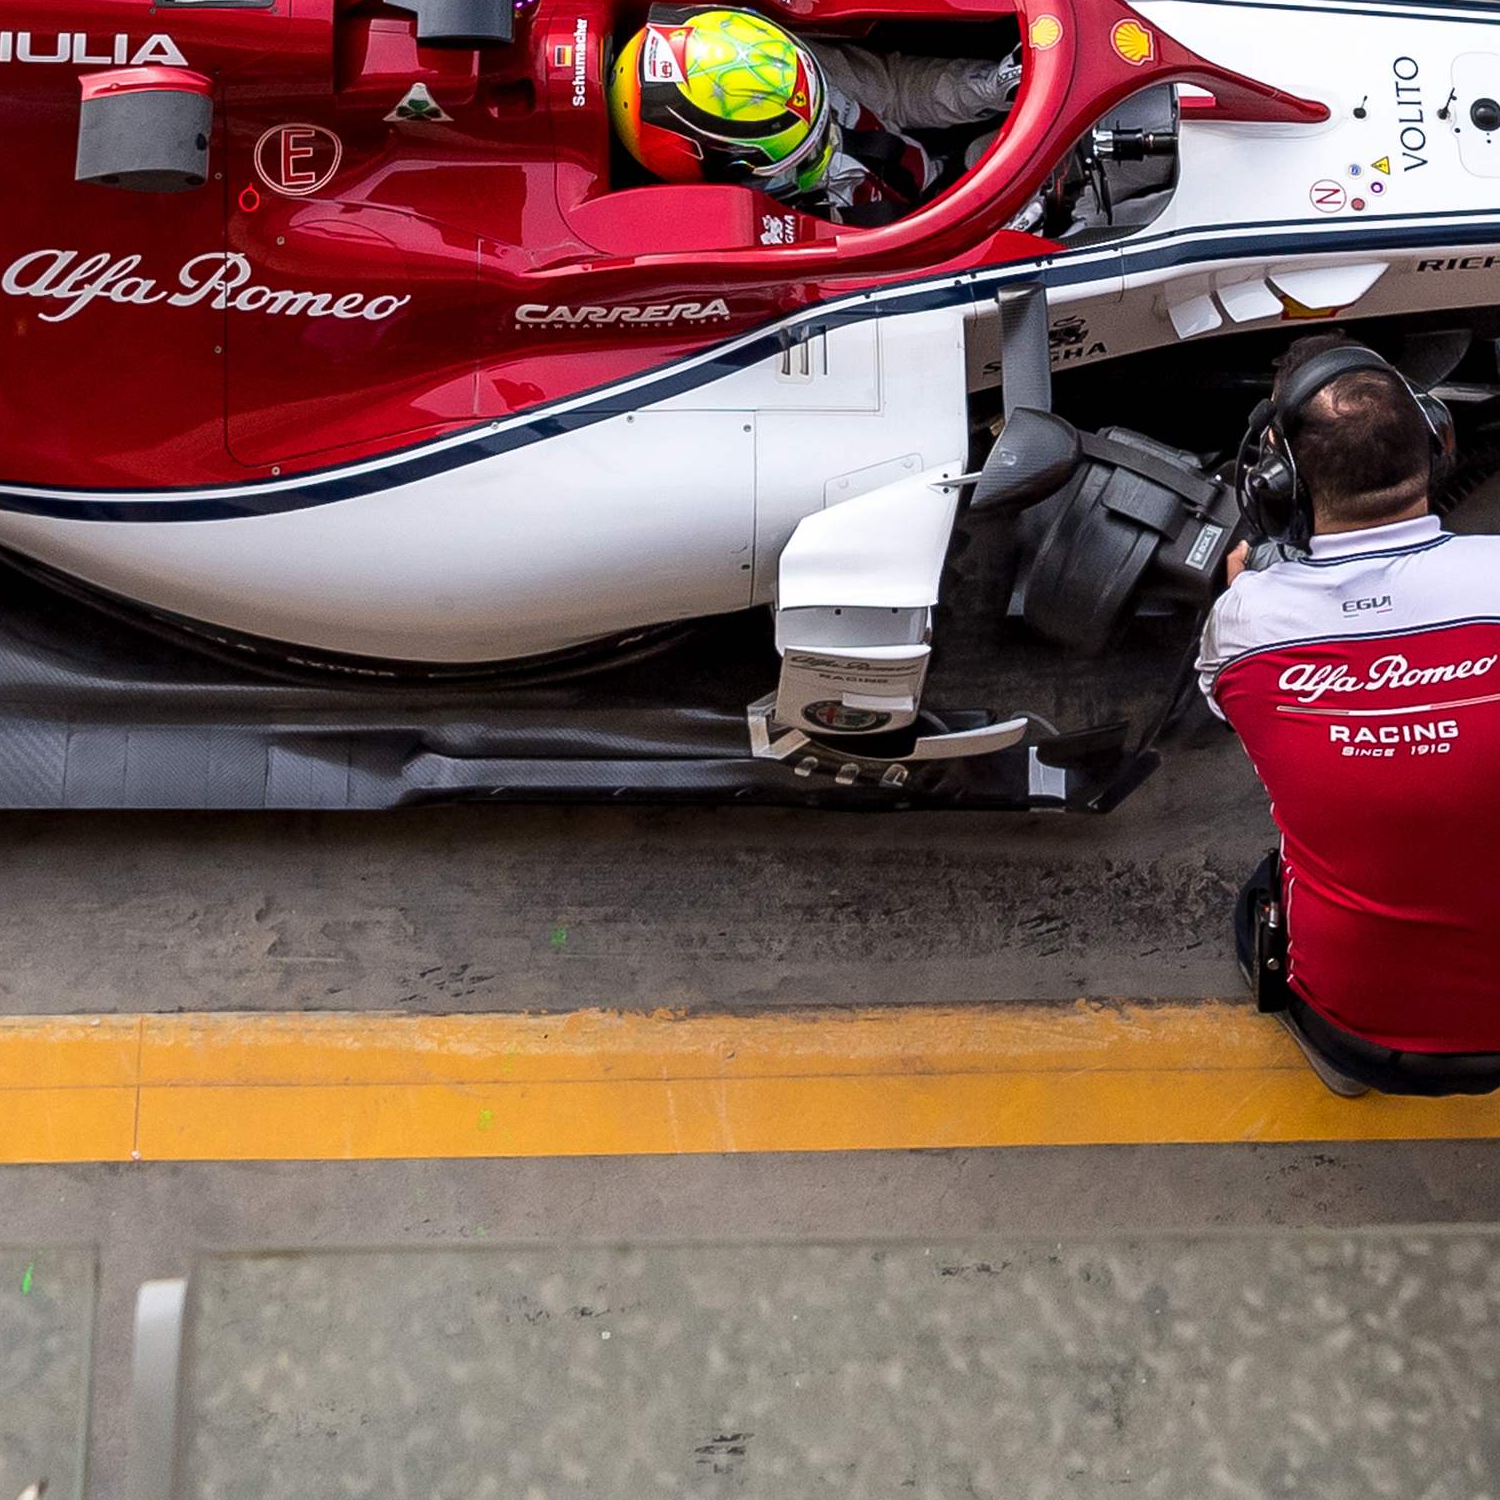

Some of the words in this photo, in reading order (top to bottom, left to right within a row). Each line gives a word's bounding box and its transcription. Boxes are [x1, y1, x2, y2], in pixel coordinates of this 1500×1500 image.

[572, 18, 588, 107] Schumacher
[1392, 55, 1429, 172] VOLITO
[280, 129, 316, 186] E
[1, 249, 168, 323] Alfa
[168, 251, 412, 321] Romeo
[515, 298, 730, 323] CARRERA
[982, 341, 1108, 376] SGHA
[1277, 663, 1365, 703] Alfa
[1365, 653, 1498, 691] Romeo
[1329, 719, 1459, 744] RACING
[1410, 742, 1451, 756] 1910
